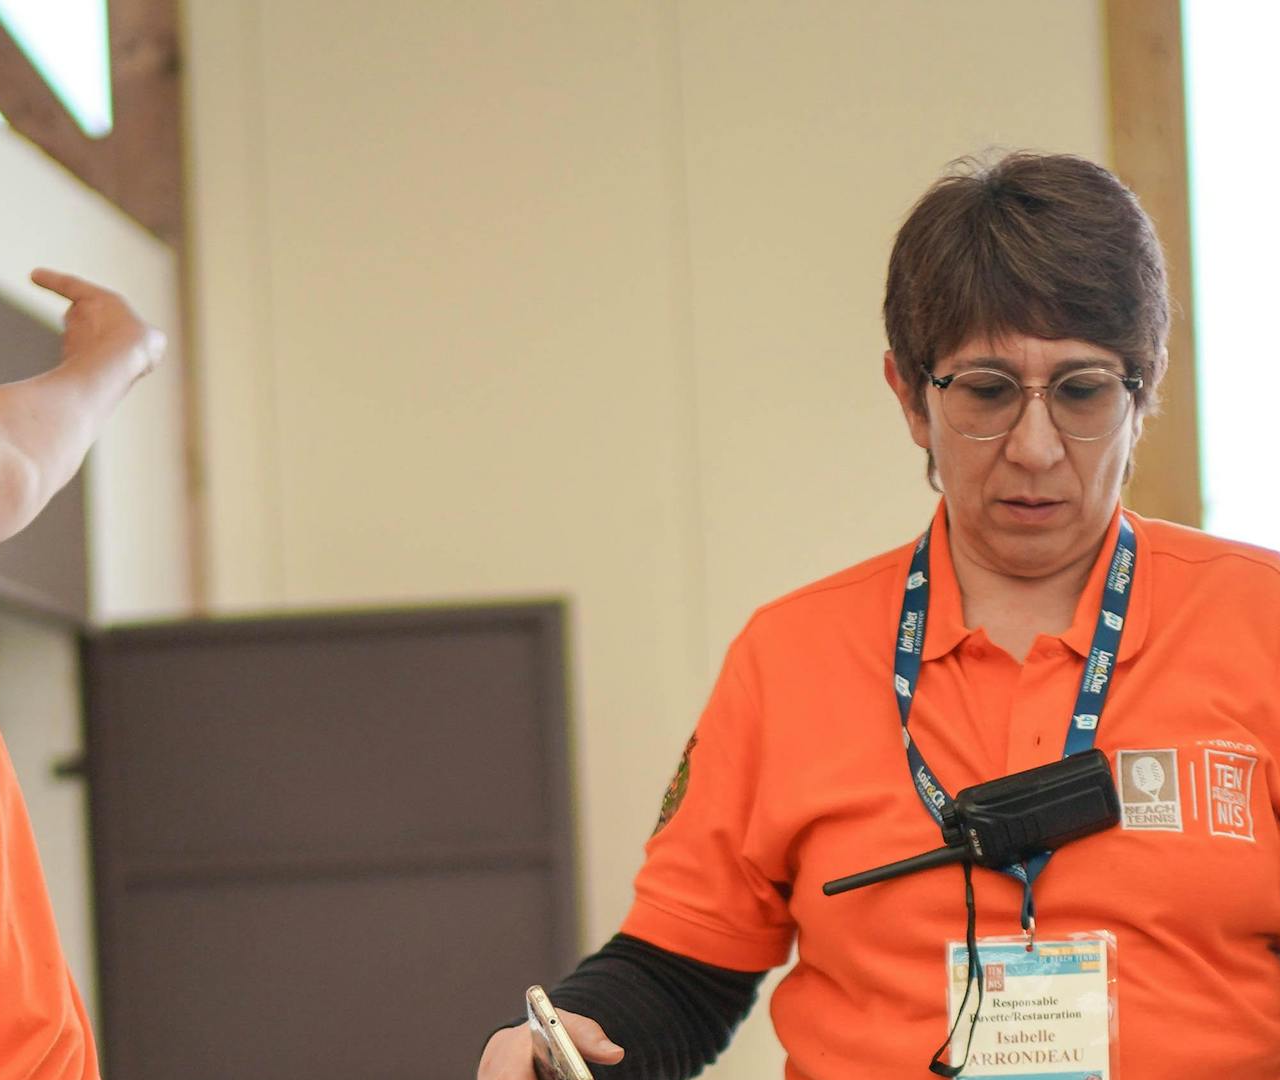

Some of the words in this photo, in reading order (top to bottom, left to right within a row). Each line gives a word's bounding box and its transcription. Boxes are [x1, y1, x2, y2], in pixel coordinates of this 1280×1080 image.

[1114, 547, 1135, 594] Loir&Cher
[898, 611, 918, 653] Loir&Cher
[1090, 649, 1114, 694] Loir&Cher
[917, 766, 946, 810] Loir&Ch
[1214, 763, 1243, 790] TEN
[1124, 803, 1176, 815] BEACH
[1127, 813, 1177, 824] TENNIS
[1217, 801, 1245, 828] NIS
[993, 996, 1059, 1009] Responsable
[997, 1029, 1056, 1044] Isabelle
